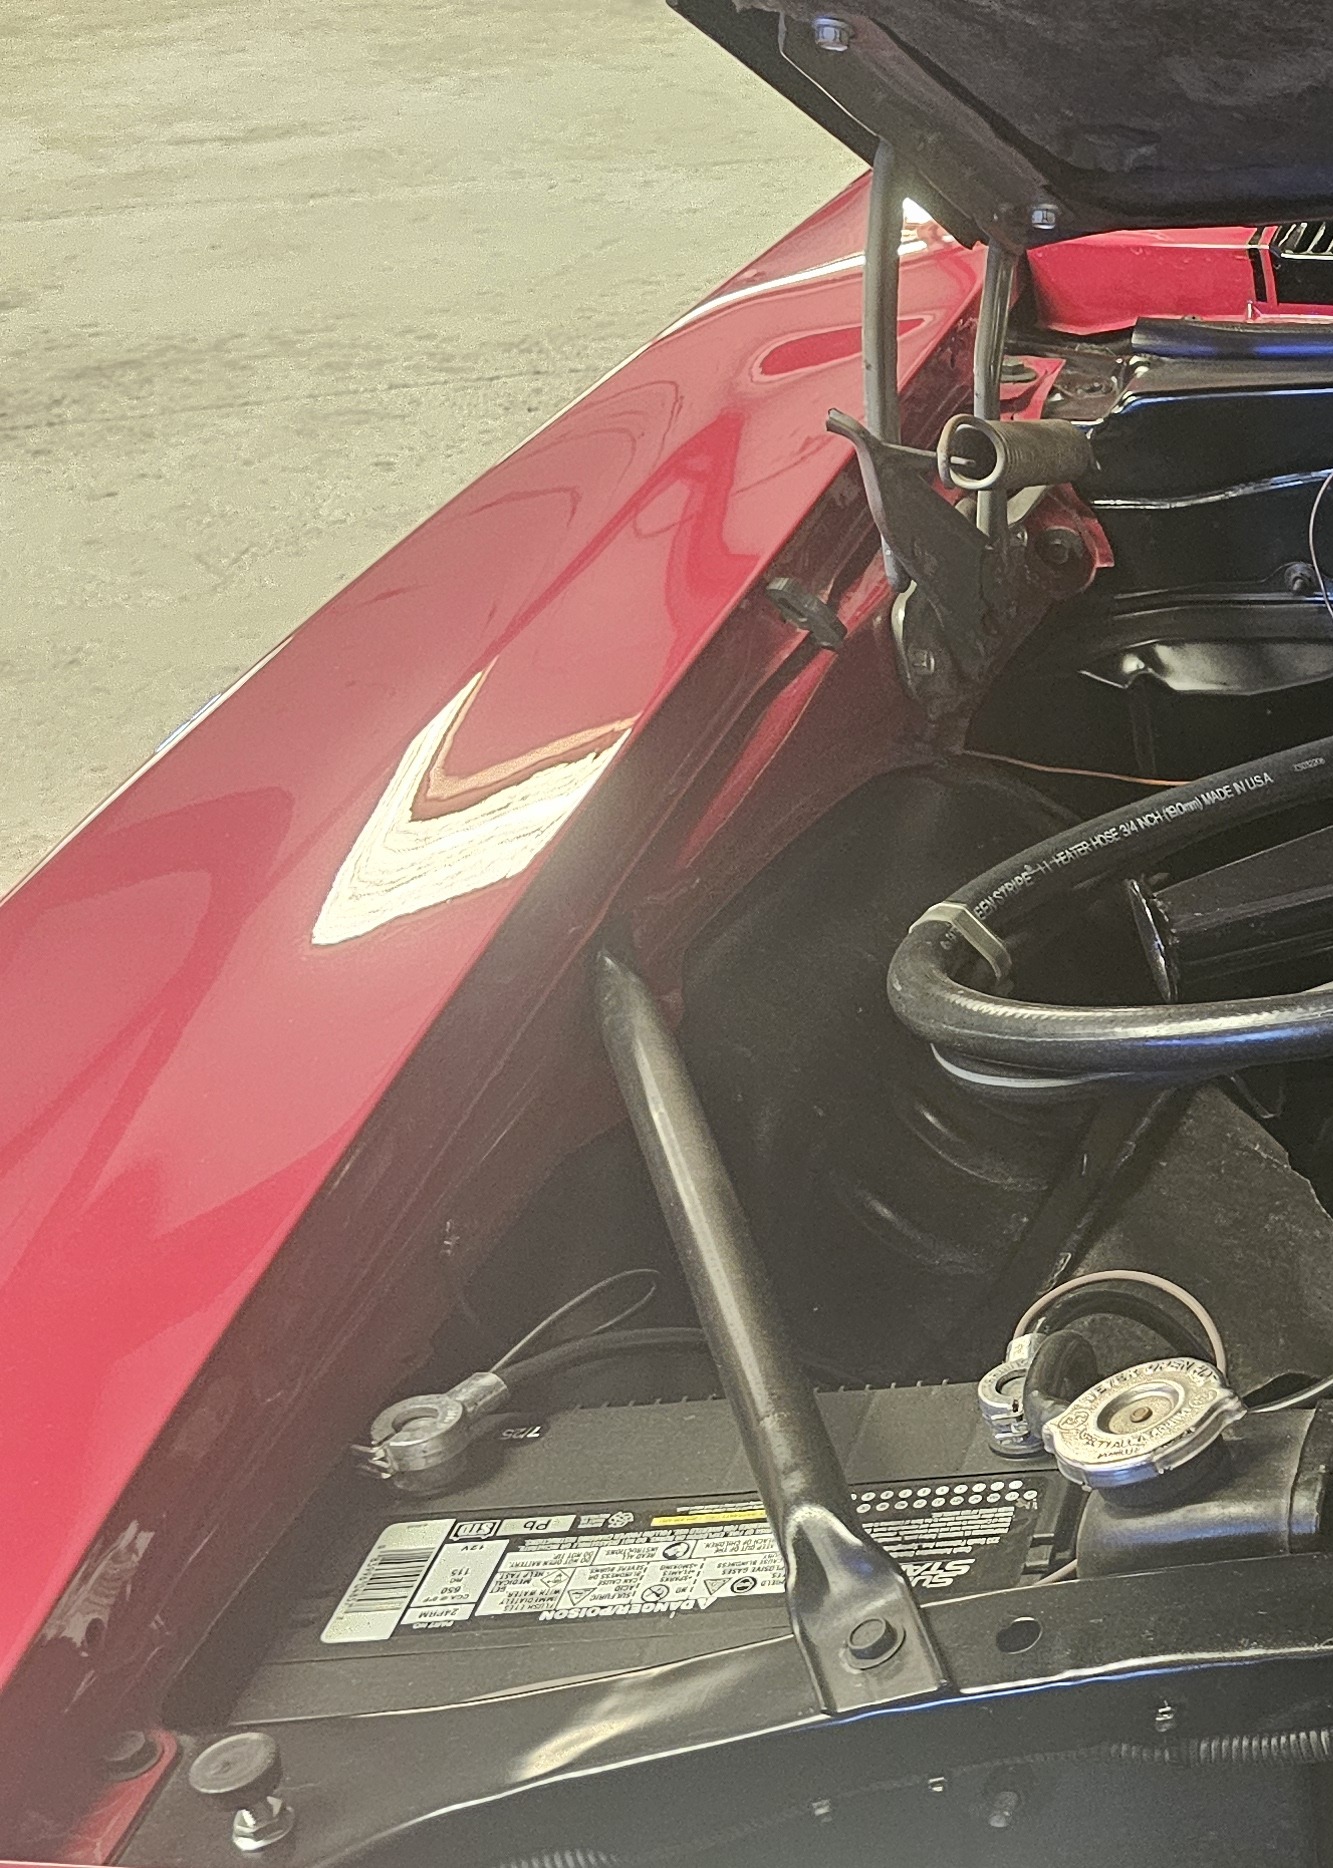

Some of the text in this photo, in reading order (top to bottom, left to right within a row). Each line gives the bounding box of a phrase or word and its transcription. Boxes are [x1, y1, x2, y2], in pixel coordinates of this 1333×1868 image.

[1089, 827, 1120, 850] HOSE
[1200, 785, 1235, 807] MADE
[1232, 780, 1247, 796] IN
[1244, 771, 1274, 791] USA
[499, 1425, 542, 1441] 7/25
[522, 1519, 553, 1531] Pb
[440, 1586, 461, 1594] 650
[539, 1599, 695, 1621] DANGER/POISON
